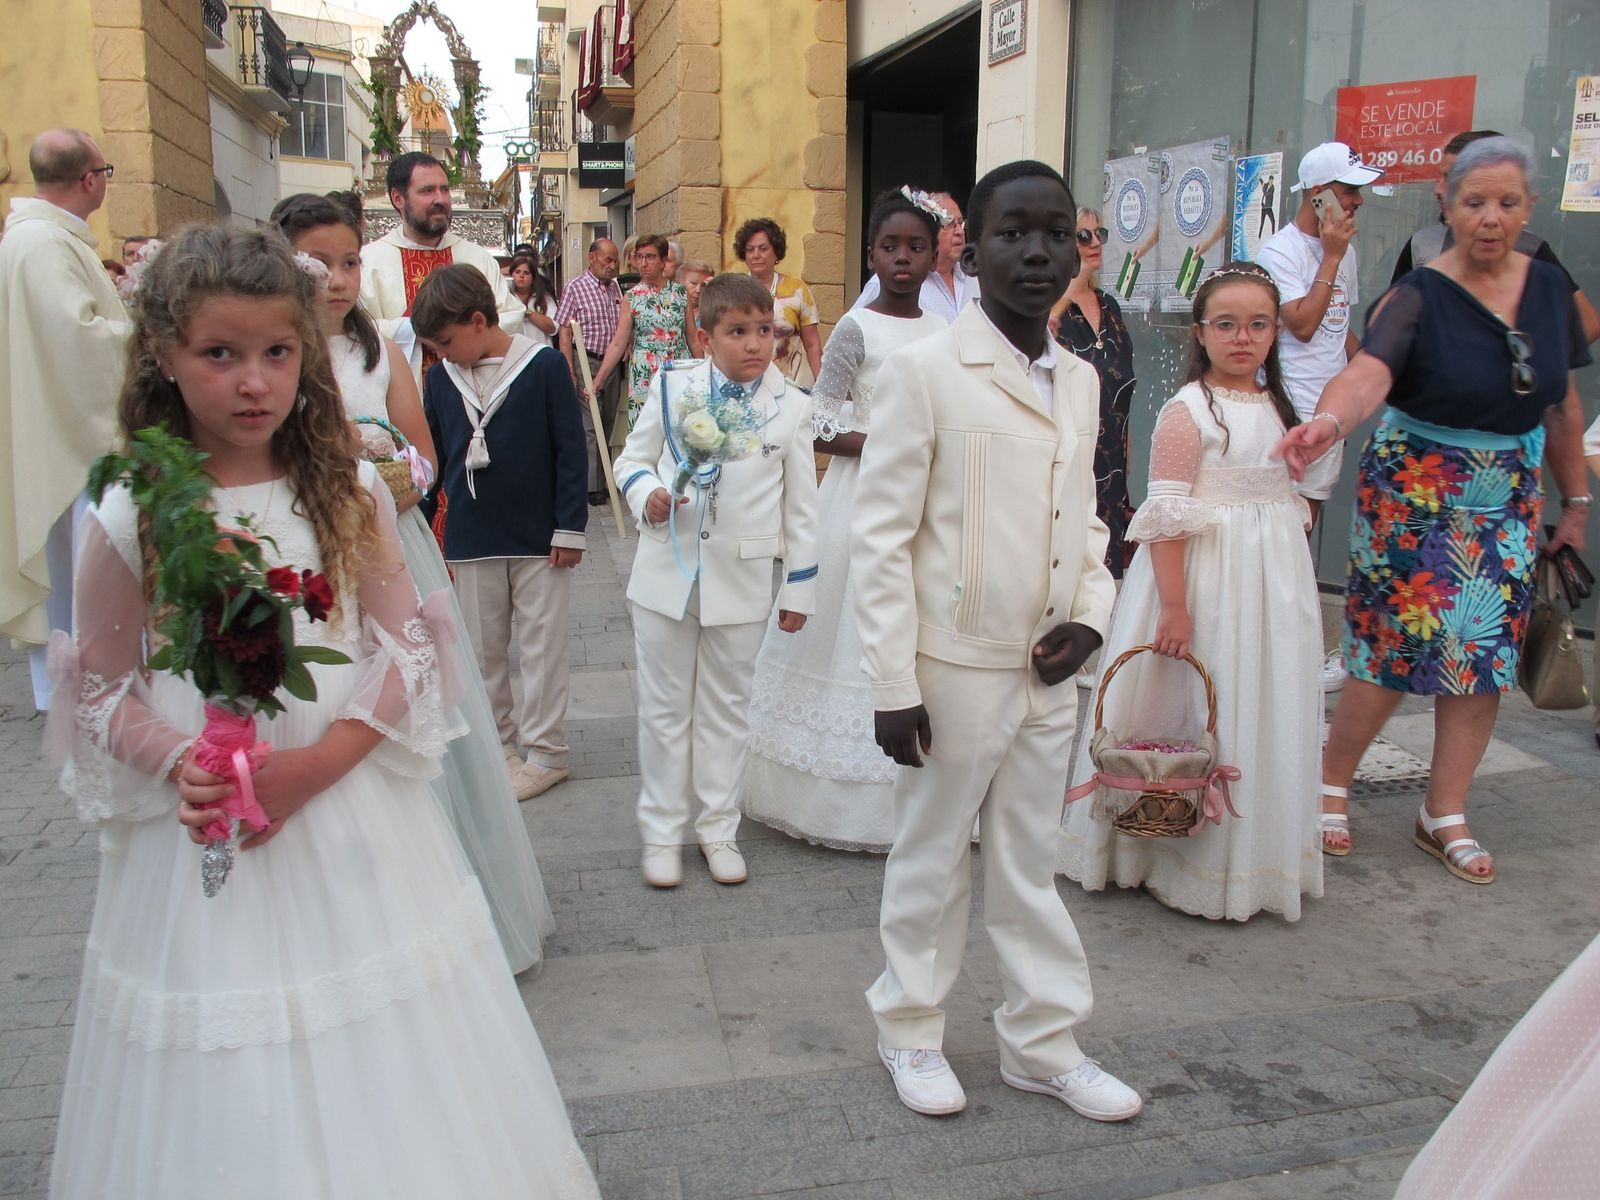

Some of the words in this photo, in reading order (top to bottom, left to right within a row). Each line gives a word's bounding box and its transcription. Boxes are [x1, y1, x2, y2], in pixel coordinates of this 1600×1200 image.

[999, 7, 1015, 28] Calle
[997, 30, 1016, 48] Mayor
[1360, 105, 1380, 123] SE
[1385, 100, 1446, 121] VENDE
[1360, 123, 1392, 139] ESTE
[1396, 120, 1443, 137] LOCAL
